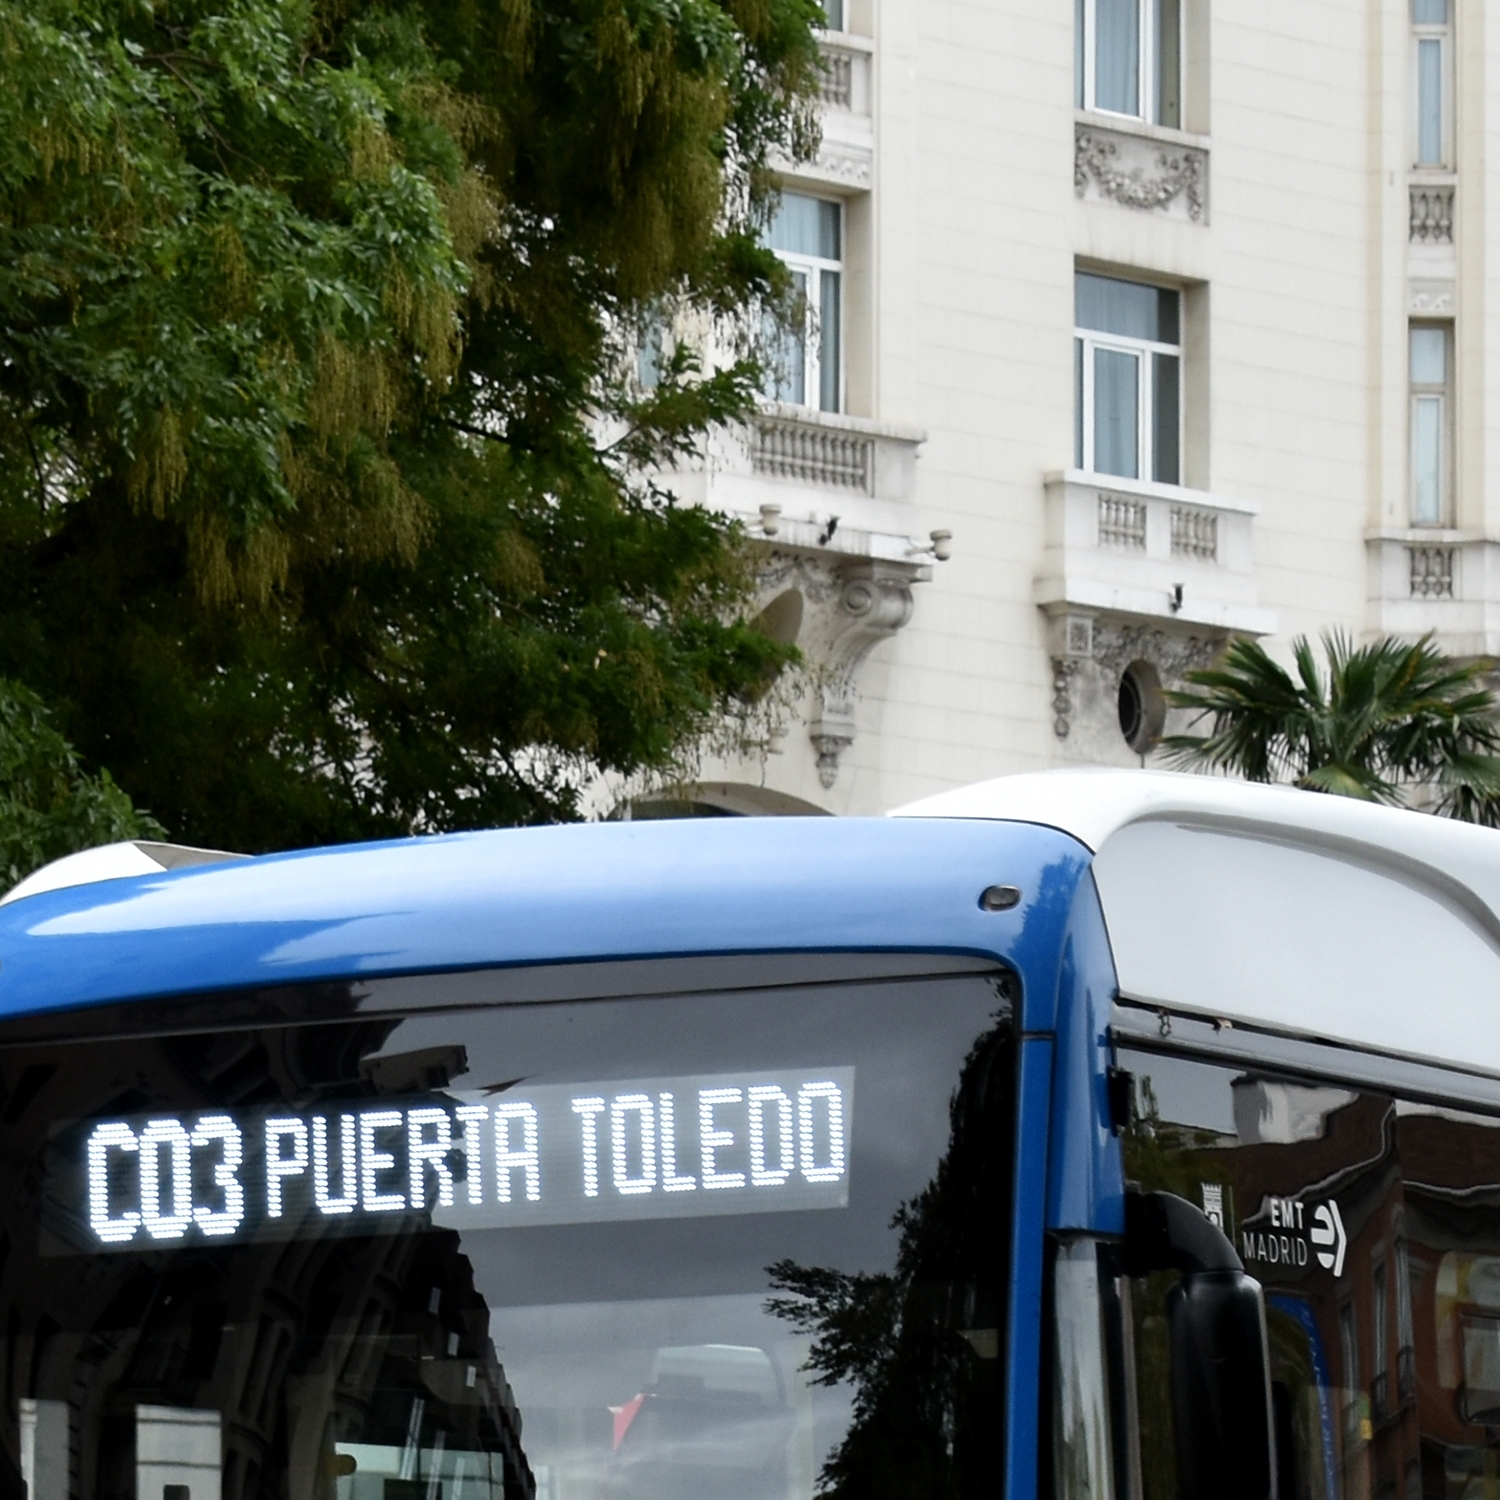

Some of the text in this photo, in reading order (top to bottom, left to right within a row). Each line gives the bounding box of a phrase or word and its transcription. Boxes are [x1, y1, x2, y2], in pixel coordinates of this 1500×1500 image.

[264, 1102, 542, 1218] PUERTA
[571, 1080, 846, 1198] TOLEDO
[1270, 1199, 1304, 1230] EMT
[1243, 1231, 1308, 1266] MADRID
